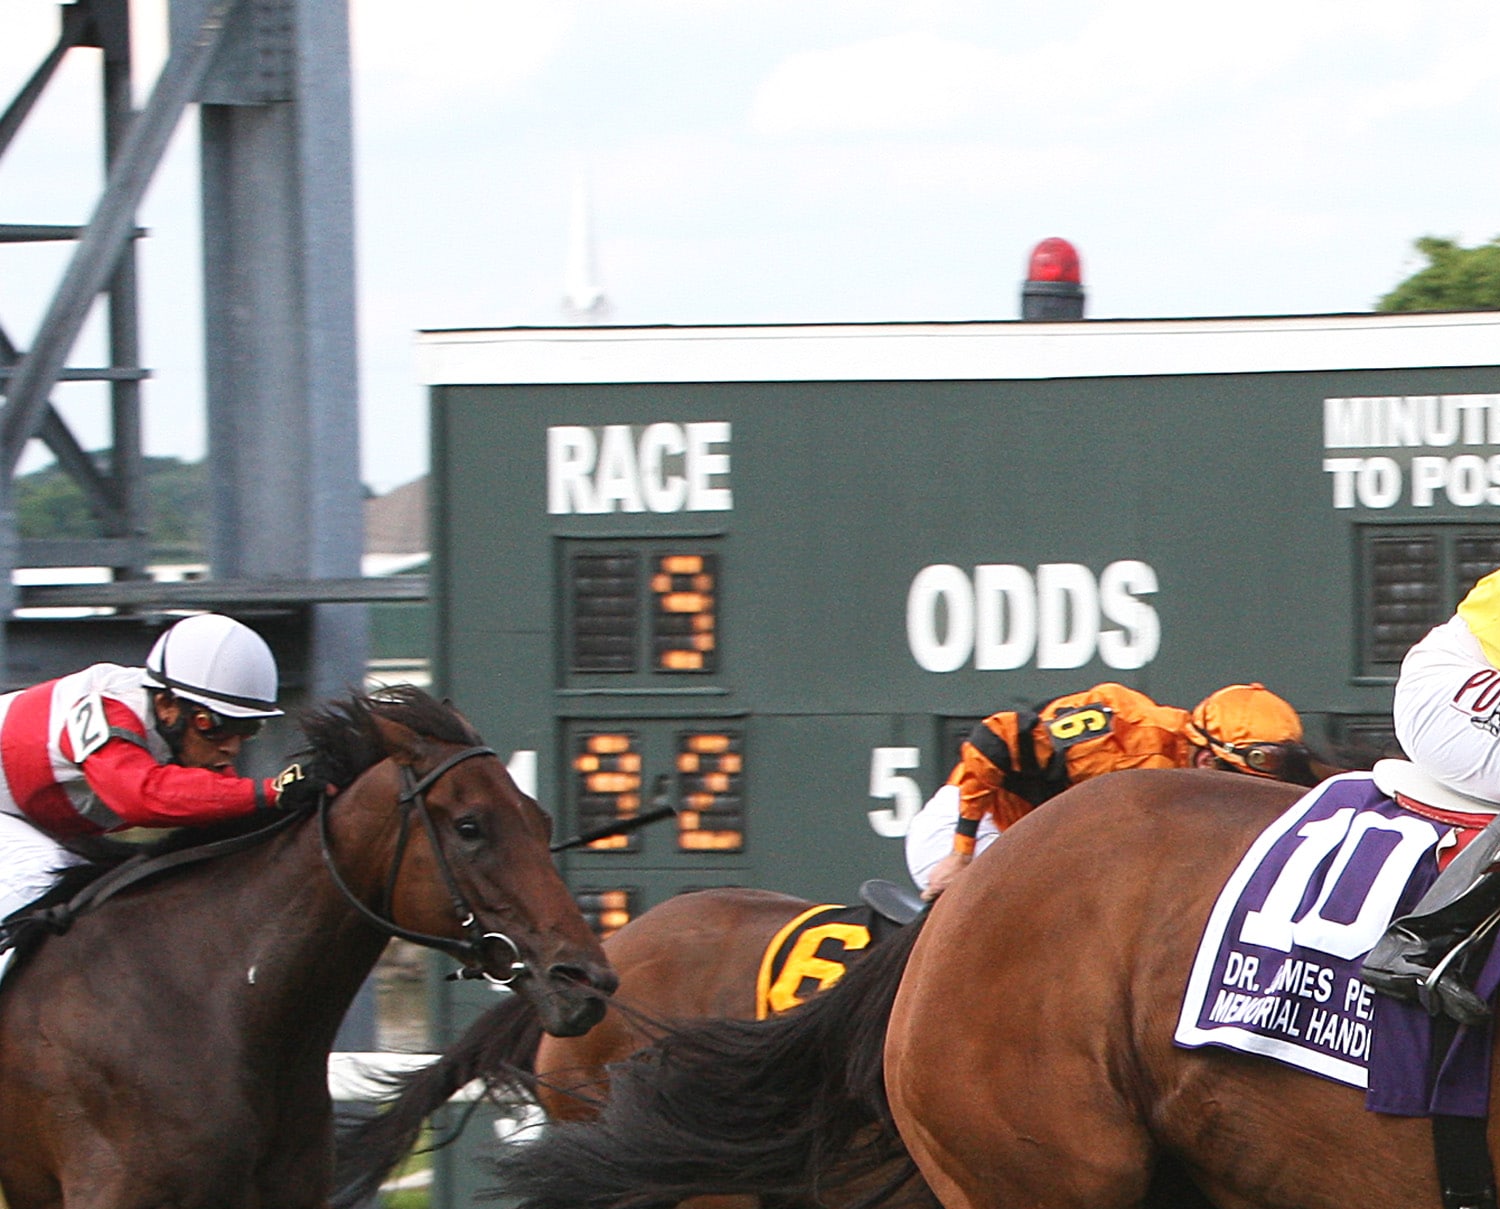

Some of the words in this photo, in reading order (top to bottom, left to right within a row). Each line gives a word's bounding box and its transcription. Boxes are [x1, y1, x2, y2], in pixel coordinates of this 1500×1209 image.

[546, 421, 733, 515] RACE
[1323, 456, 1402, 509] TO
[651, 554, 714, 671] 9
[906, 560, 1161, 672] ODDS
[75, 702, 100, 744] 2
[868, 747, 920, 837] 5
[1239, 807, 1440, 961] 10
[1222, 951, 1261, 992] DR.
[1344, 977, 1376, 1021] PE
